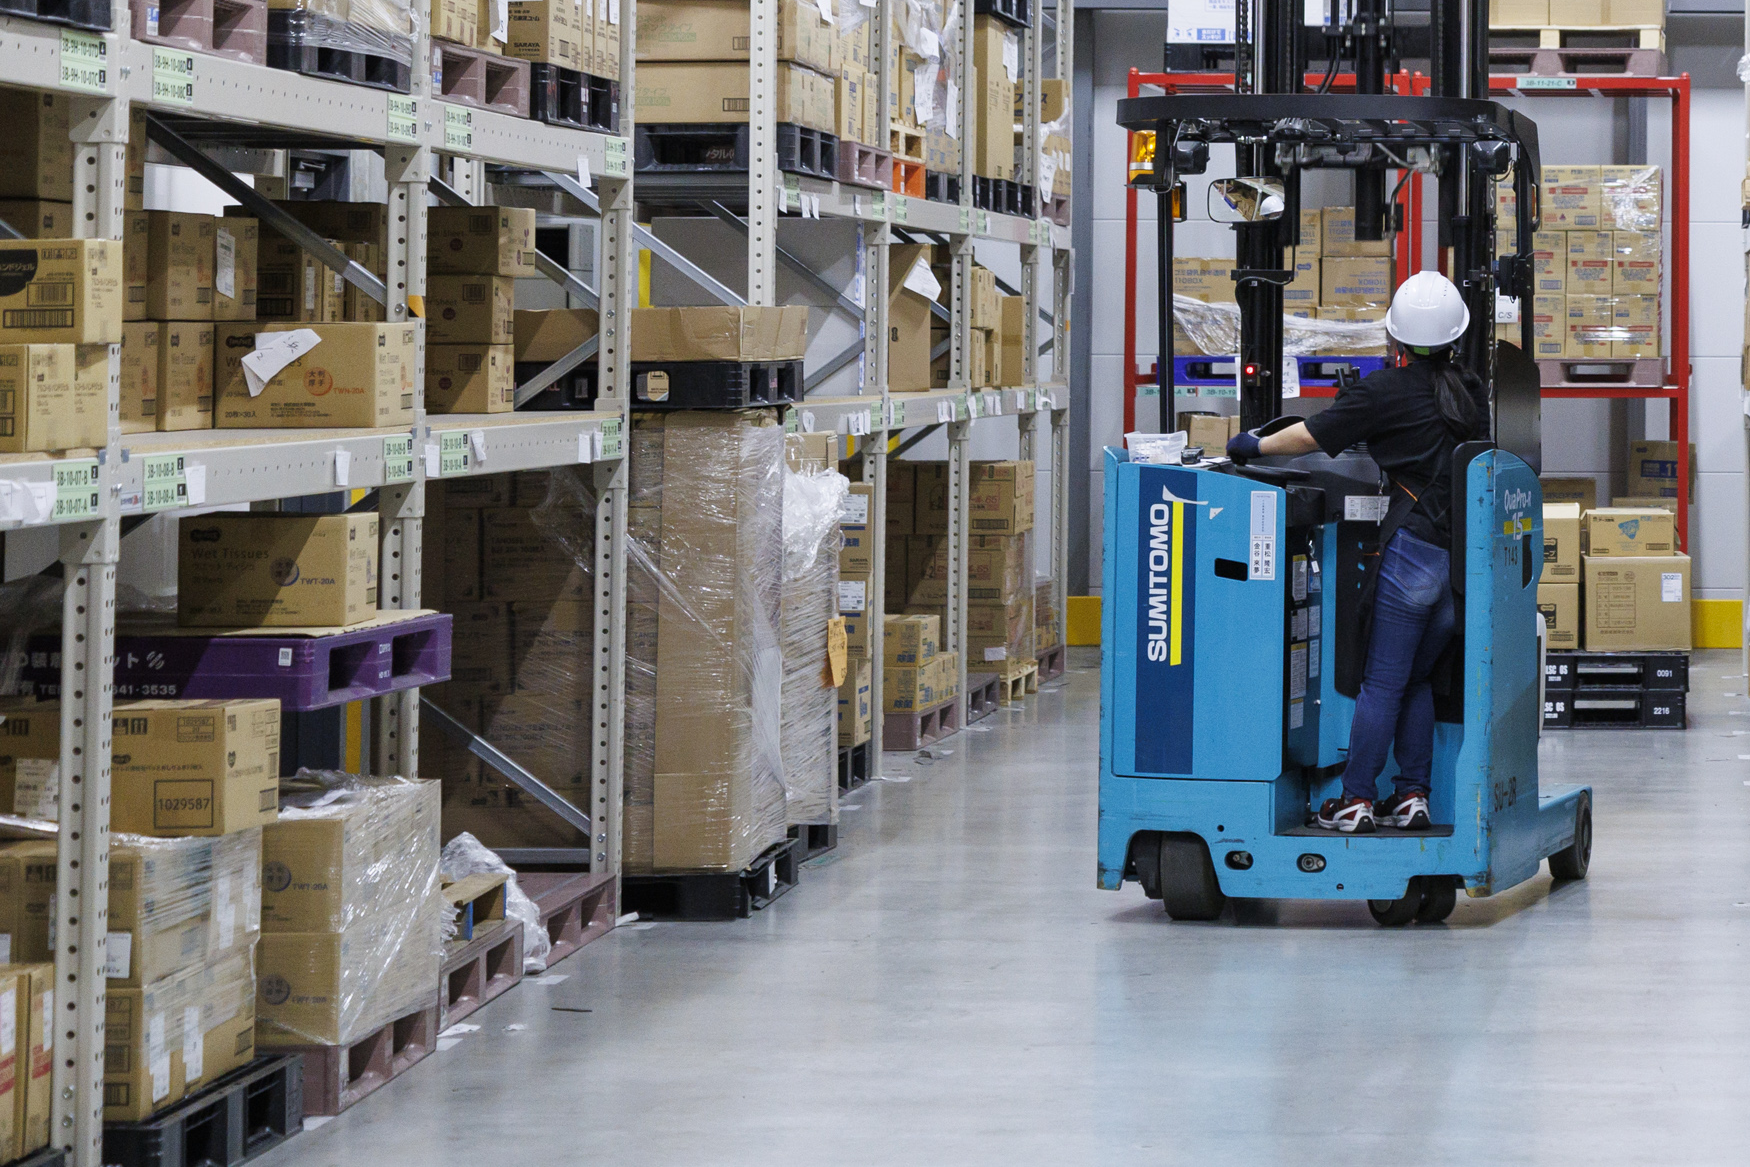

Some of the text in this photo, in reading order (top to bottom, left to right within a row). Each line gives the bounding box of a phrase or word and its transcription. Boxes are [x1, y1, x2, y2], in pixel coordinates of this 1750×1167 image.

[1497, 311, 1512, 319] C/S
[57, 470, 88, 486] 3B-10-07-B
[56, 499, 88, 515] 3B-10-07-A
[1512, 512, 1523, 540] 15
[223, 547, 270, 559] Tissues
[1147, 503, 1169, 662] SUMITOMO
[1657, 670, 1673, 678] 0091
[158, 798, 210, 811] 1029587
